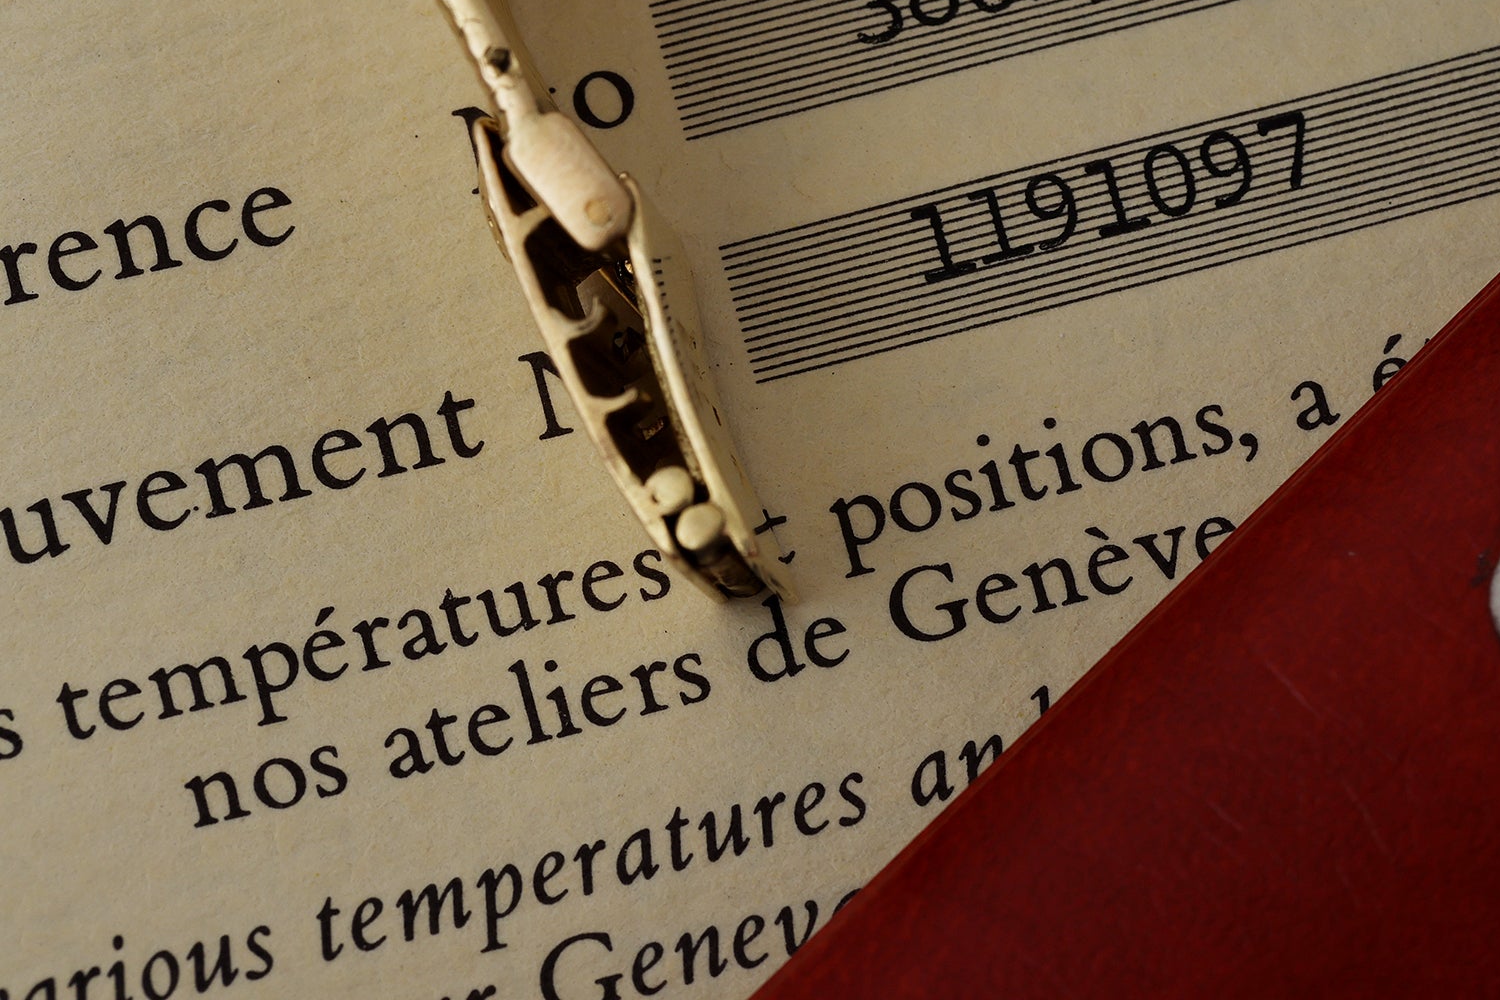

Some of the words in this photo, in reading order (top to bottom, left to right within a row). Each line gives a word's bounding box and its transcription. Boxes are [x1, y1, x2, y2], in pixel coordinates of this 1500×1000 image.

[0, 185, 296, 306] rence
[451, 70, 635, 194] o
[0, 390, 486, 565] uvement
[910, 109, 1308, 284] 1191097
[56, 548, 671, 740] températures
[832, 403, 1259, 578] positions,
[1290, 380, 1341, 432] a
[184, 745, 348, 829] nos
[383, 649, 711, 780] ateliers
[746, 594, 851, 683] de
[888, 516, 1237, 642] Genève
[0, 923, 275, 1000] rious
[317, 771, 867, 962] temperatures
[911, 684, 1051, 807] an
[539, 887, 864, 1000] Genev
